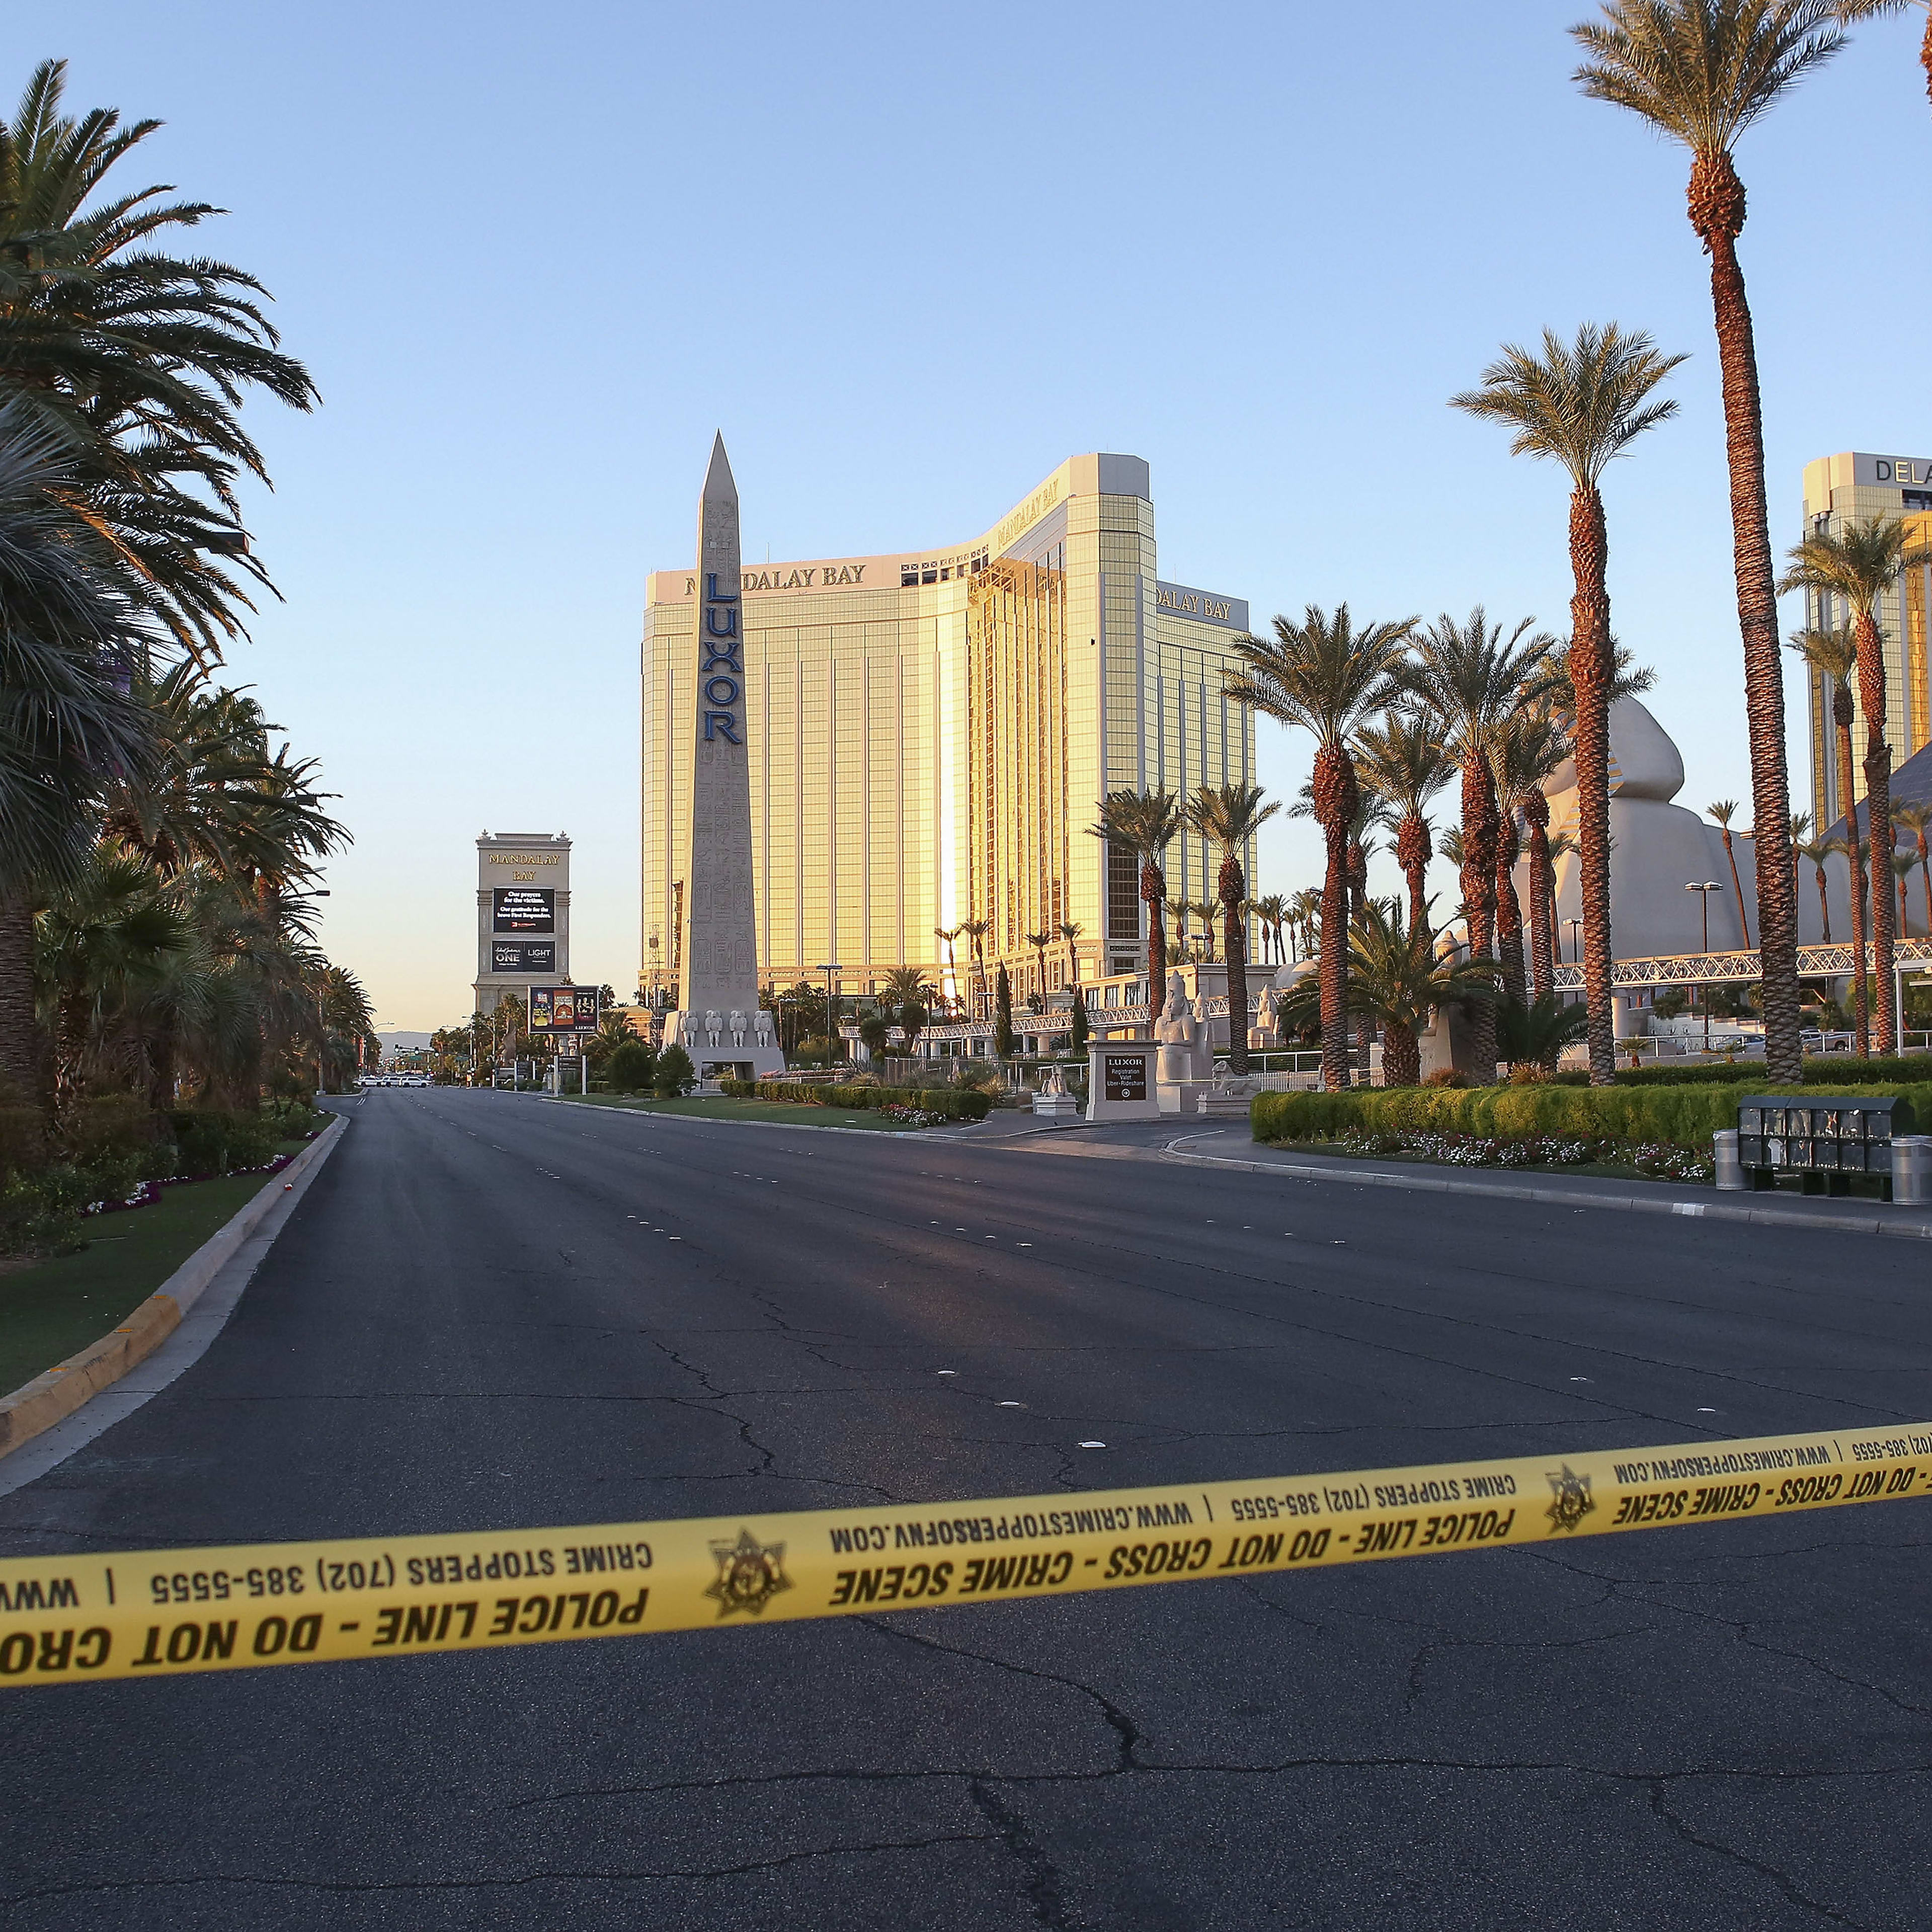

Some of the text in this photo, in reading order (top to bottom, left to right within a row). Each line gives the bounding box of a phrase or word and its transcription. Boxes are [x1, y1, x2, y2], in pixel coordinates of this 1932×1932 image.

[998, 478, 1058, 549] MANDALAY BAY
[822, 565, 866, 586] BAY
[1203, 598, 1231, 620] BAY
[702, 573, 742, 744] LUXOR
[489, 854, 559, 865] MANDALAY
[513, 870, 535, 880] BAY
[1614, 1445, 1831, 1483] WWW.CRIMESTOPPERSOFNV.COM
[1852, 1439, 1909, 1461] 385-5555
[1324, 1484, 1370, 1512] (702)
[1375, 1480, 1461, 1507] STOPPERS
[1463, 1475, 1516, 1498] CRIME
[1775, 1474, 1843, 1506] CROSS
[1842, 1470, 1887, 1499] NOT
[1886, 1467, 1916, 1494] DO
[1232, 1493, 1320, 1521] 385-5555
[1612, 1490, 1688, 1524] SCENE
[1688, 1482, 1761, 1516] CRIME
[830, 1502, 1193, 1553] WWW.CRIMESTOPPERSOFNV.COM
[1288, 1528, 1332, 1562] DO
[1353, 1519, 1418, 1554] LINE
[1419, 1509, 1516, 1547] POLICE
[407, 1550, 555, 1586] STOPPERS
[564, 1543, 653, 1574] CRIME
[1104, 1538, 1213, 1579] CROSS
[1218, 1533, 1285, 1569] NOT
[151, 1566, 305, 1604] 385-5555
[316, 1553, 395, 1592] (702)
[829, 1561, 954, 1606] SCENE
[958, 1551, 1074, 1594] CRIME
[372, 1601, 479, 1647] LINE
[489, 1588, 650, 1637] POLICE
[132, 1620, 238, 1667] NOT
[253, 1613, 324, 1657] DO
